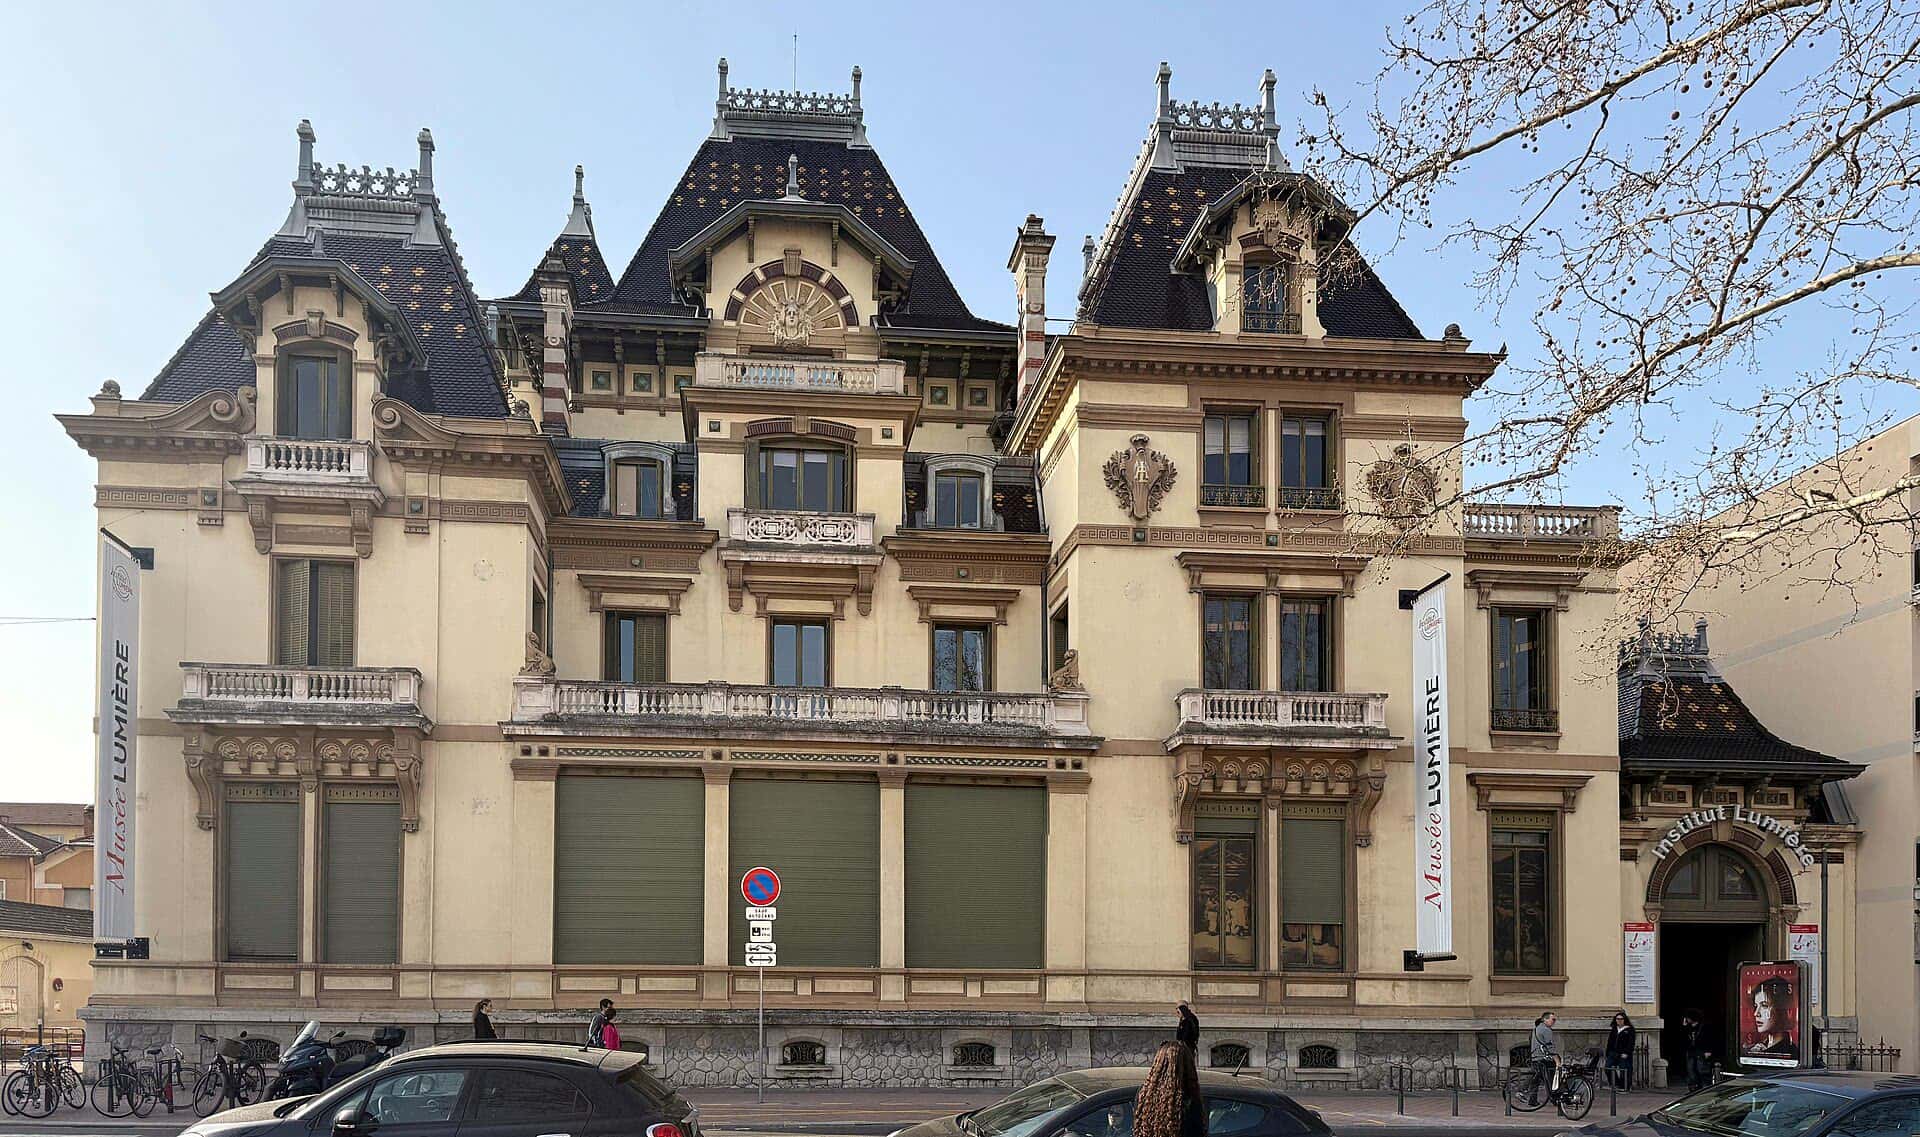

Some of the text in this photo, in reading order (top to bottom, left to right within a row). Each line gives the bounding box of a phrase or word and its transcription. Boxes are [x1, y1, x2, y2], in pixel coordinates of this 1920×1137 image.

[106, 639, 129, 896] Musée LUMIÈRE
[1424, 674, 1442, 913] Musée LUMIÈRE
[1651, 804, 1815, 867] Institut Lumière
